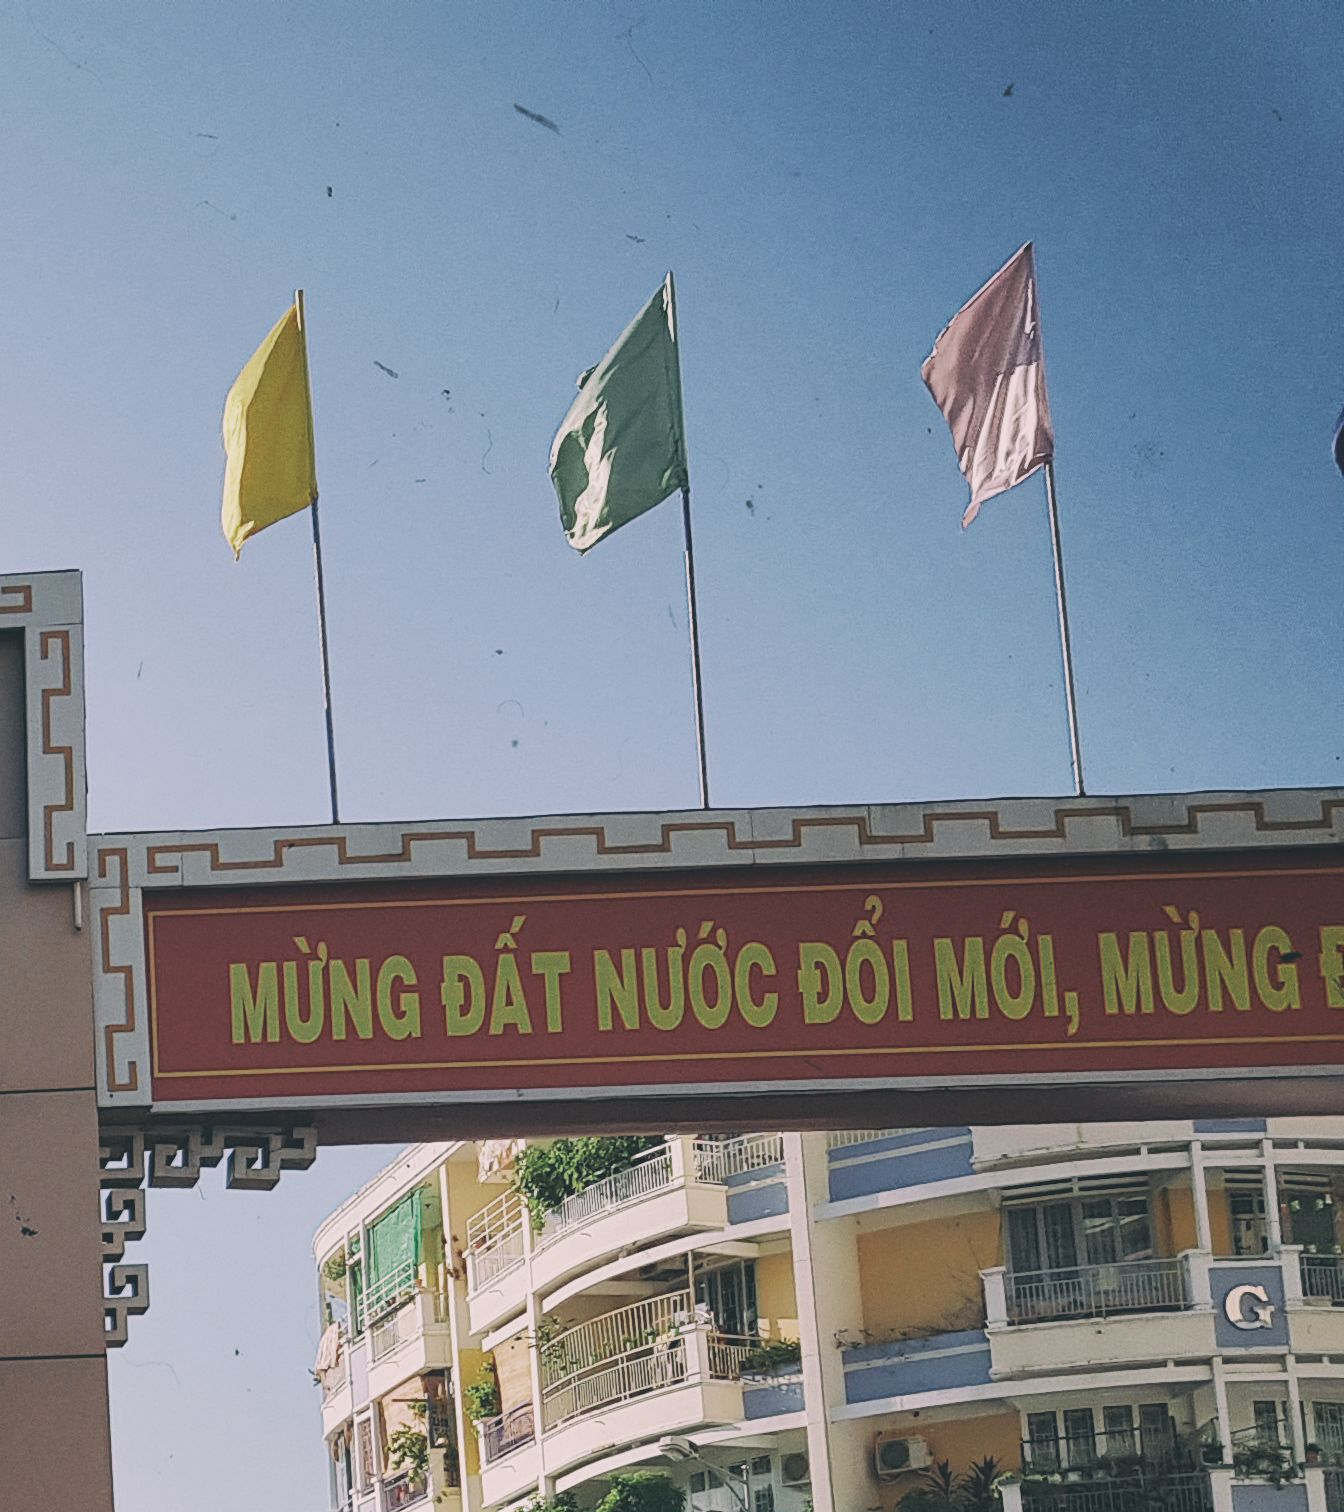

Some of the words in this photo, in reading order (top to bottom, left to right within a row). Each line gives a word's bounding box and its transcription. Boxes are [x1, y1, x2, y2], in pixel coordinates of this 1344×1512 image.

[227, 934, 422, 1045] MỪNG
[441, 916, 571, 1038] ĐẤT
[593, 920, 779, 1032] NƯỚC
[797, 895, 913, 1026] ĐỔI
[935, 909, 1078, 1037] MỚI,
[1099, 904, 1301, 1018] MỪNG
[1225, 1284, 1275, 1331] G
